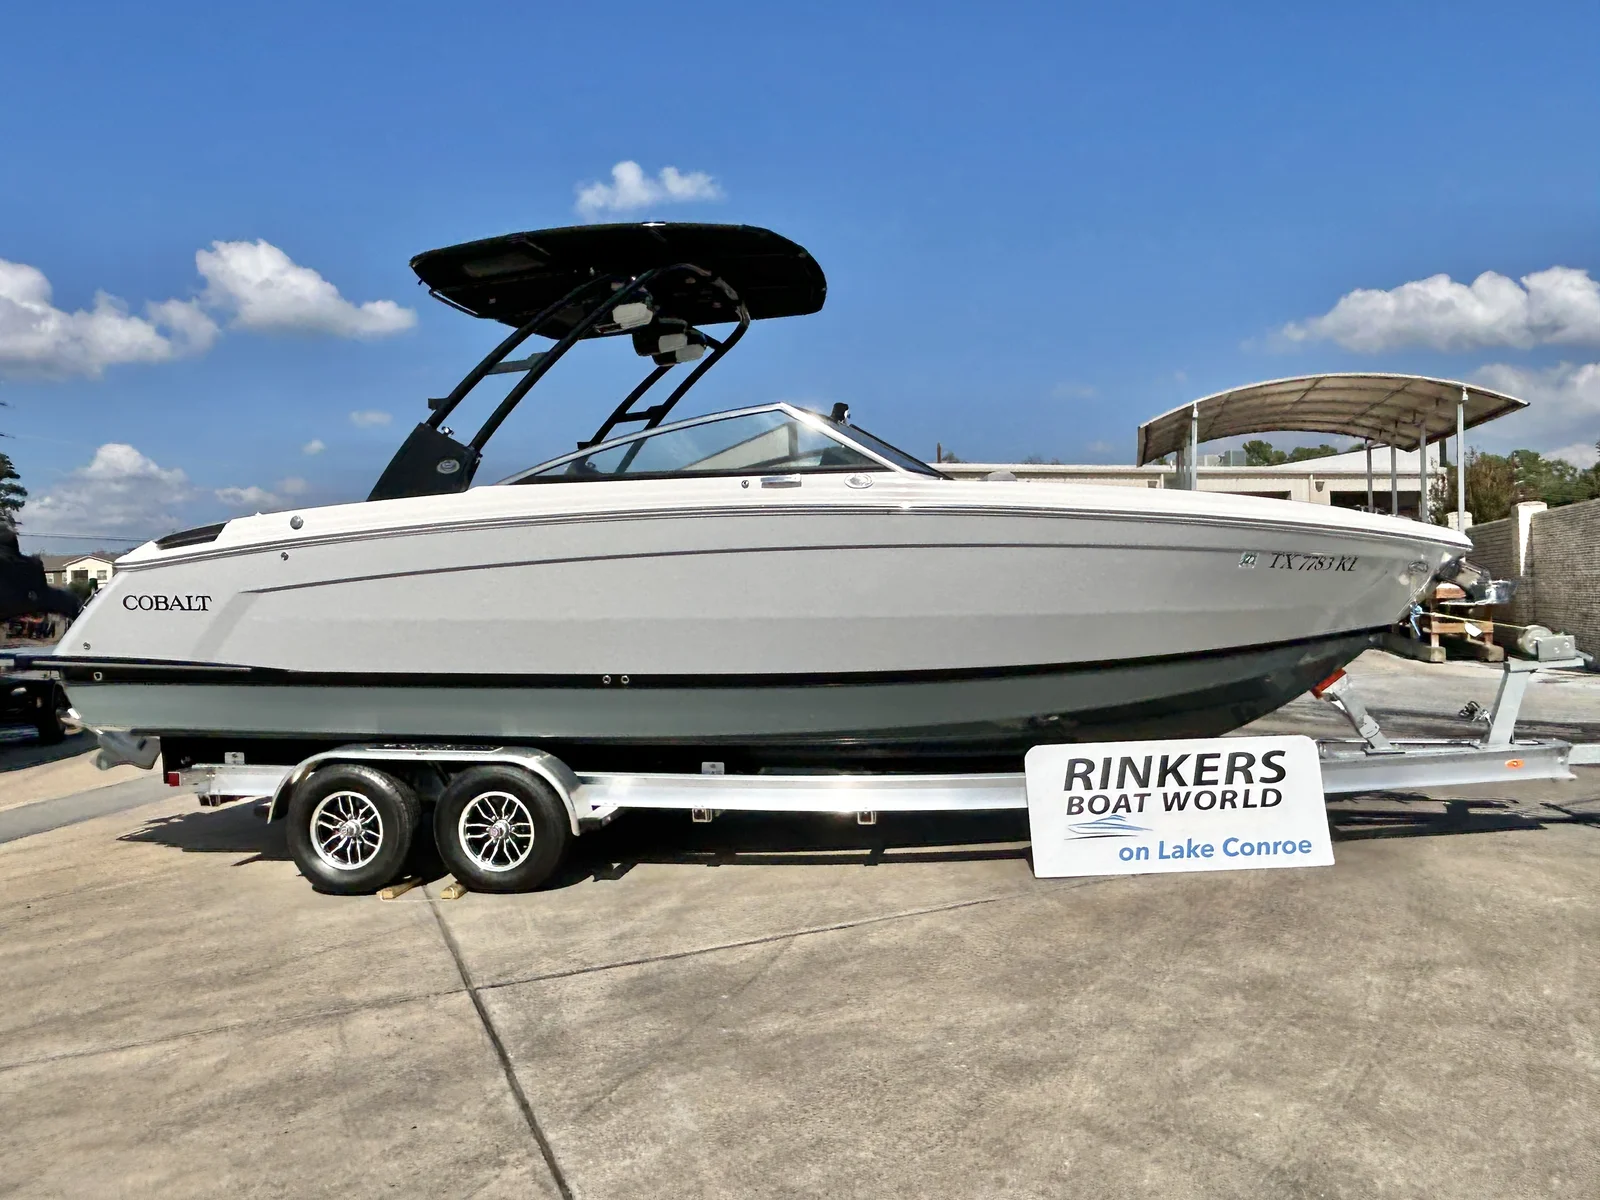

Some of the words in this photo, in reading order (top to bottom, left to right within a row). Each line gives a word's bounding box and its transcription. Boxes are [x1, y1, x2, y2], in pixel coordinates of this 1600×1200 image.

[1268, 551, 1300, 570] TX
[122, 594, 213, 612] COBALT
[1063, 749, 1287, 792] RINKERS
[1066, 792, 1152, 816] BOAT
[1162, 787, 1283, 812] WORLD
[1118, 846, 1150, 862] on
[1158, 837, 1215, 860] Lake
[1222, 837, 1312, 857] Conroe
